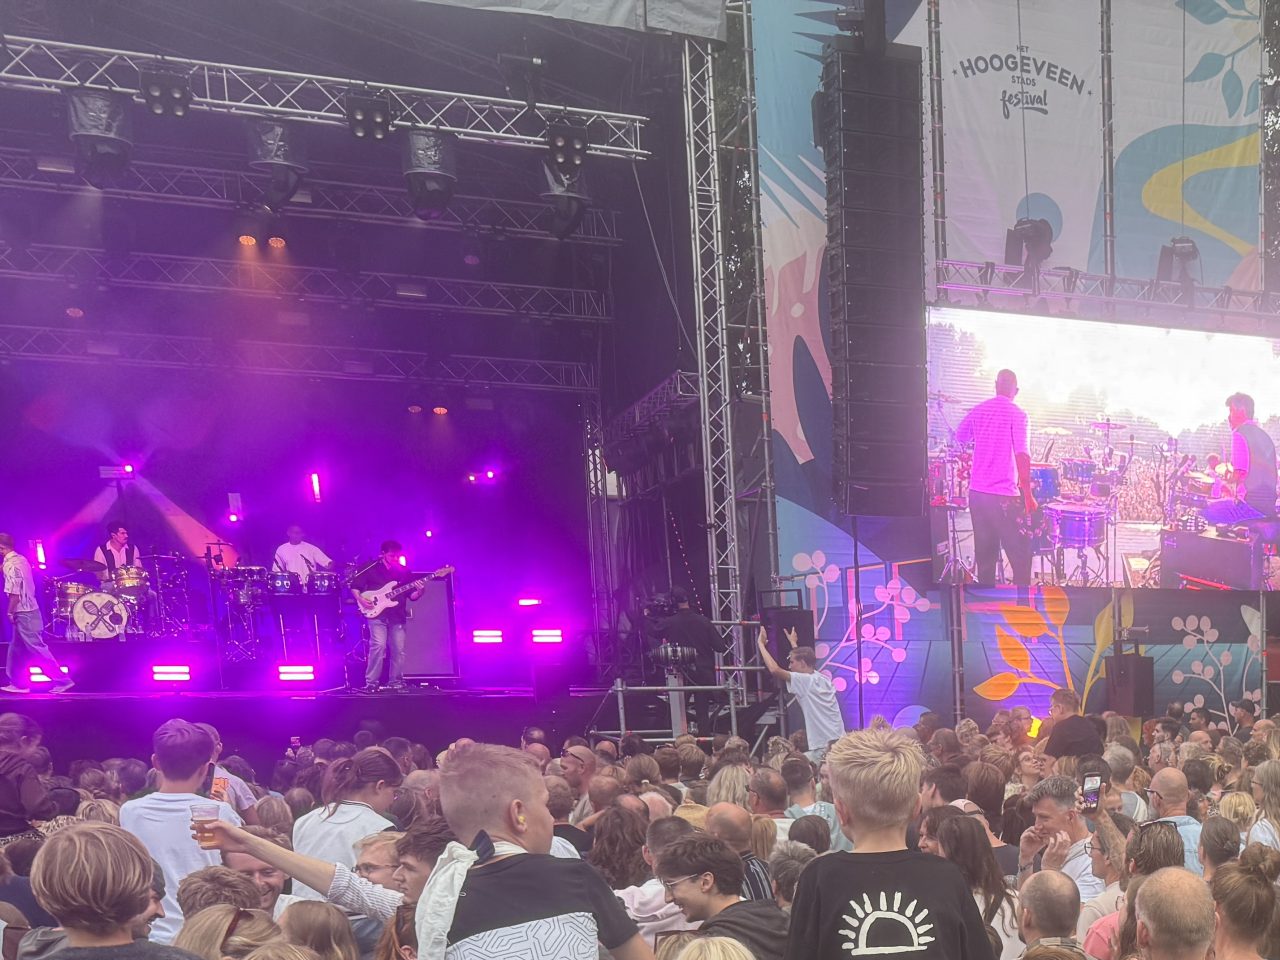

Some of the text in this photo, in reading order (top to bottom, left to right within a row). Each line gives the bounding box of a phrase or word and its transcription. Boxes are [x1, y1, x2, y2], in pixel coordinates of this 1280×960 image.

[1016, 45, 1029, 53] HET
[960, 54, 1085, 95] HOOGEVEEN
[1011, 75, 1036, 87] STADS
[1000, 89, 1048, 119] festival
